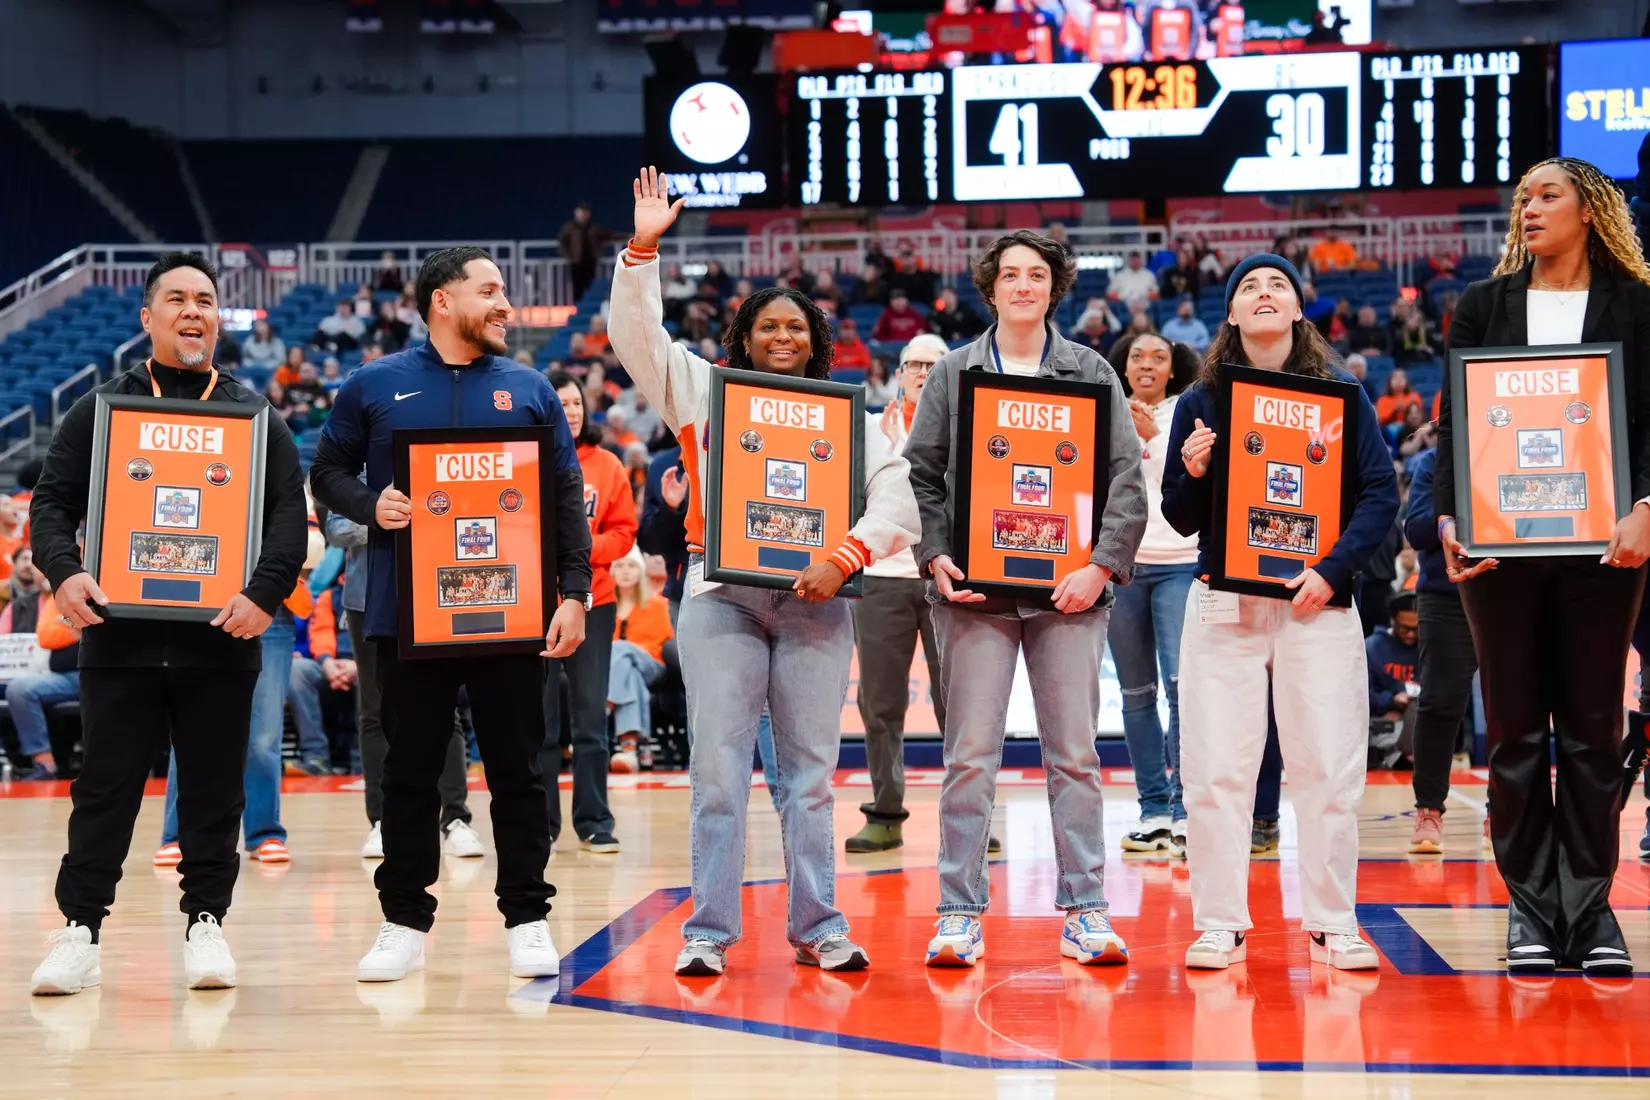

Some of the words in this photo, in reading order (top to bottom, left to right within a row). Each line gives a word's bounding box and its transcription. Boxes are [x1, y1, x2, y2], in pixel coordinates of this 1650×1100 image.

[1413, 56, 1443, 77] PTS
[1110, 65, 1197, 111] 12:36
[989, 102, 1039, 166] 41
[1266, 93, 1325, 158] 30
[1499, 370, 1571, 395] 'CUSE
[492, 390, 512, 411] S
[754, 397, 818, 429] 'CUSE
[1256, 397, 1314, 430] 'CUSE
[1001, 401, 1064, 431] 'CUSE
[144, 423, 215, 453] 'CUSE
[439, 453, 506, 480] 'CUSE
[1017, 483, 1032, 491] FINAL
[161, 504, 177, 513] FINAL
[461, 536, 476, 544] FINAL
[476, 536, 491, 544] FOUR
